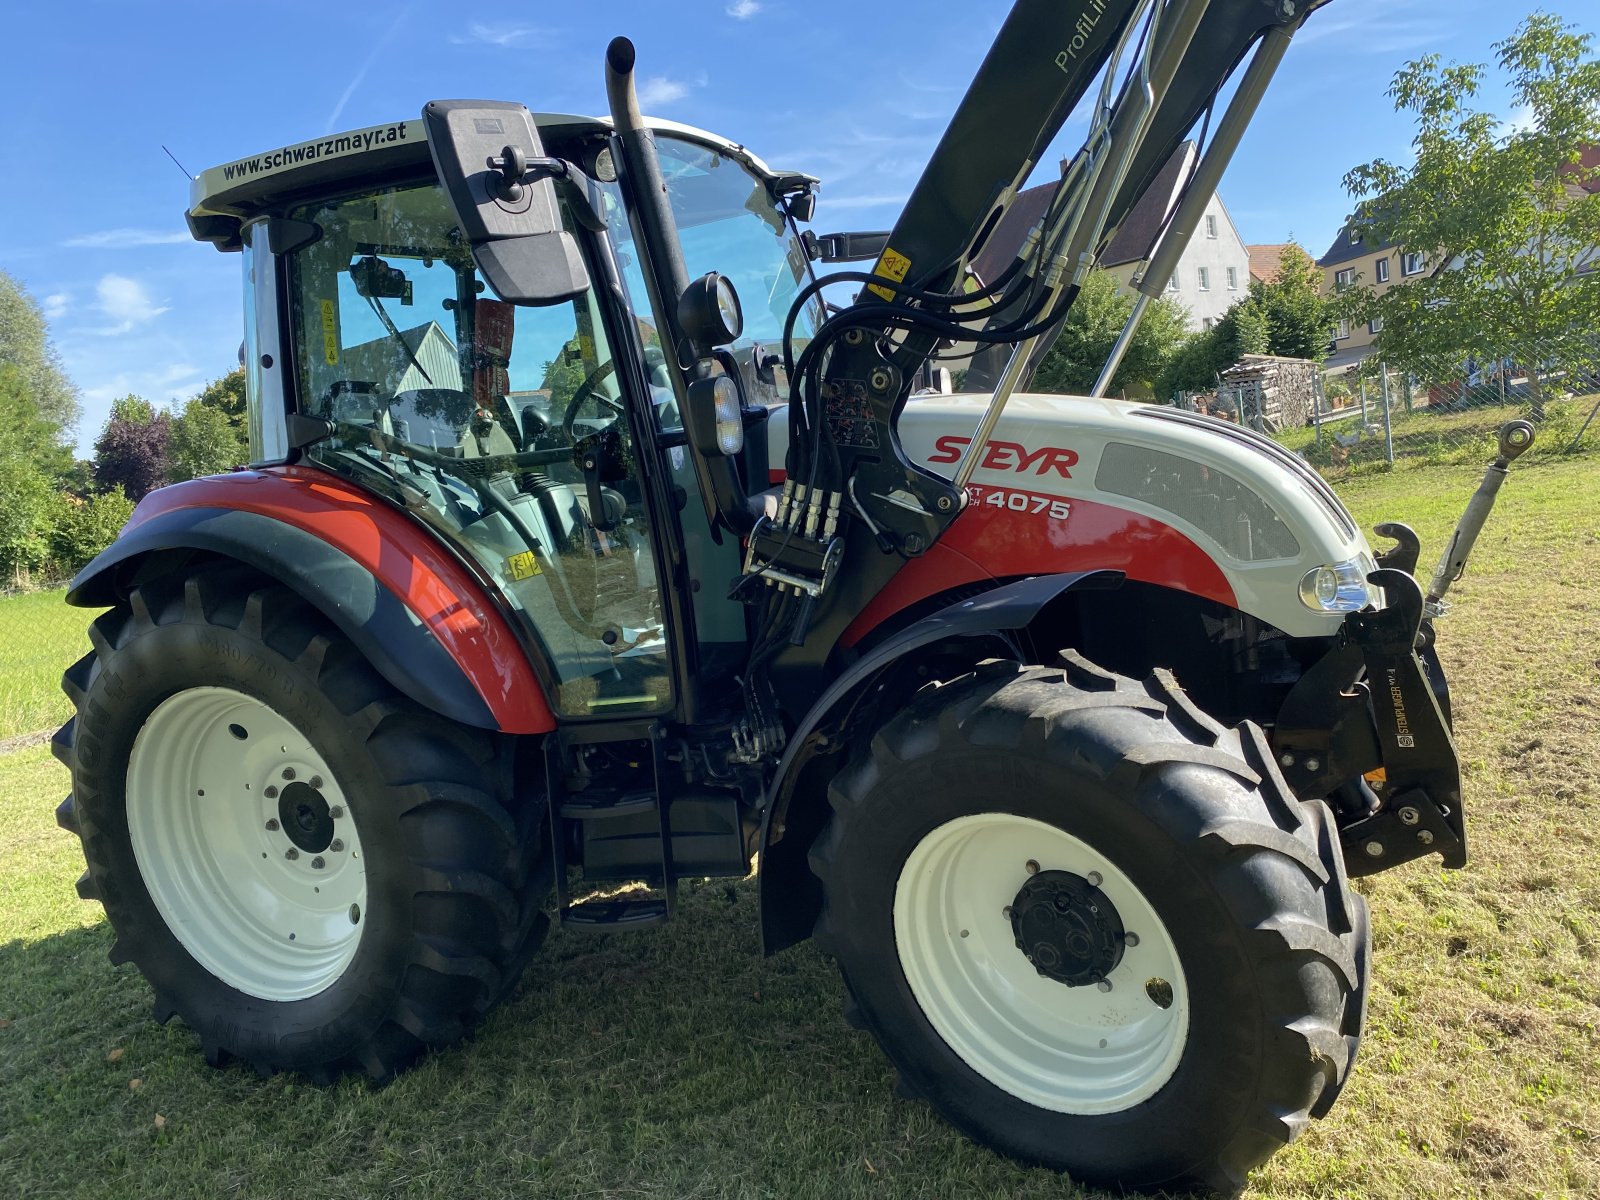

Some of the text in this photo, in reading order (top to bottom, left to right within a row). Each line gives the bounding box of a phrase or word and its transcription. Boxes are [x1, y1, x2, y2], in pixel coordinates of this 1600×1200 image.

[223, 121, 407, 181] www.schwarzmayr.at
[986, 491, 1071, 520] 4075
[1391, 686, 1409, 733] STEMPLINGER
